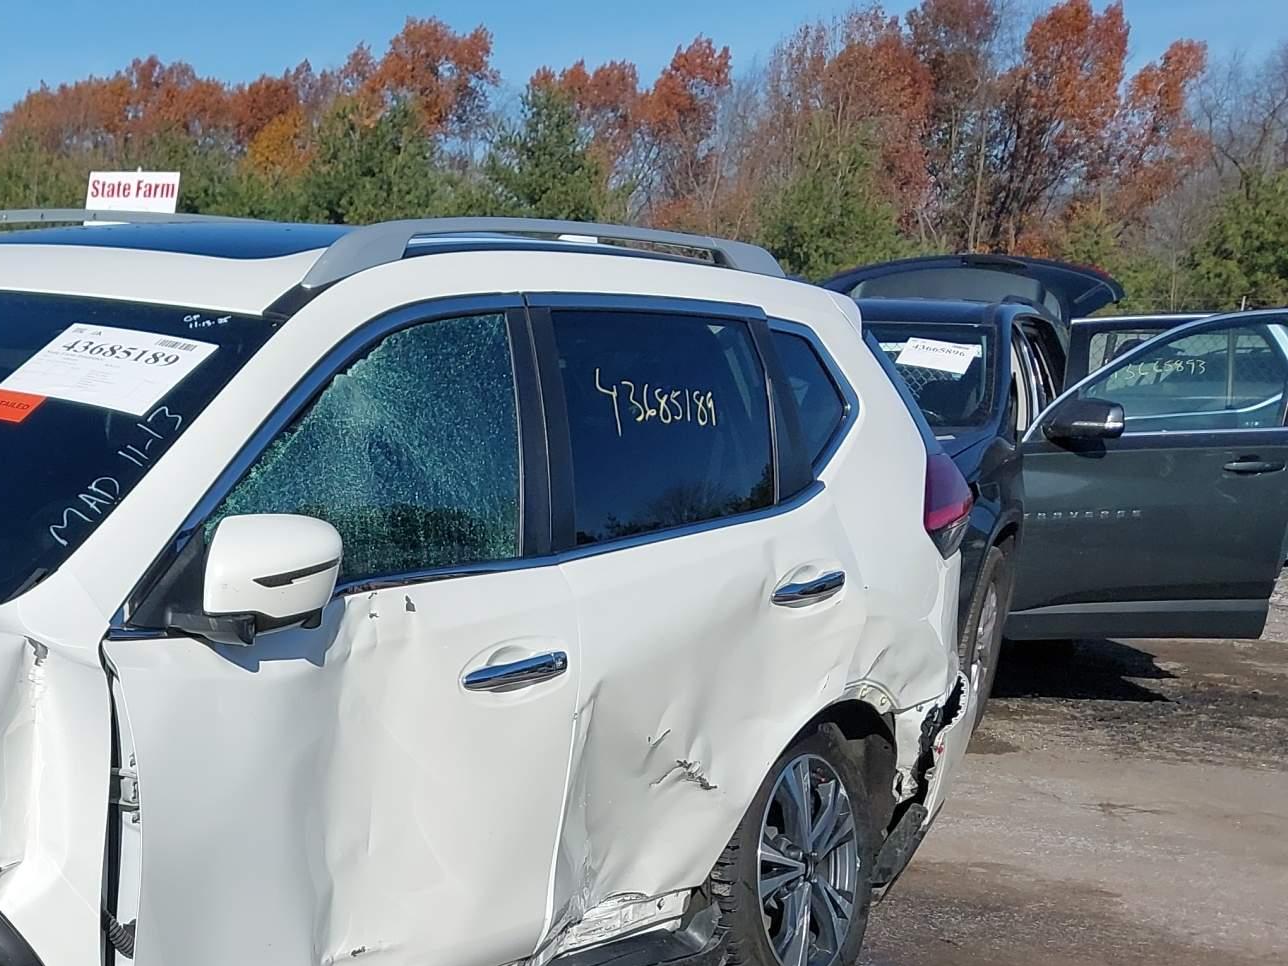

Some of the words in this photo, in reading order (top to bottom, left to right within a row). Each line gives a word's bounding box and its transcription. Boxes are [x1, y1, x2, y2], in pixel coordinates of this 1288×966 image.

[91, 179, 132, 199] State
[135, 179, 176, 199] Farm
[62, 339, 180, 366] 43685189
[595, 367, 717, 437] 43685189
